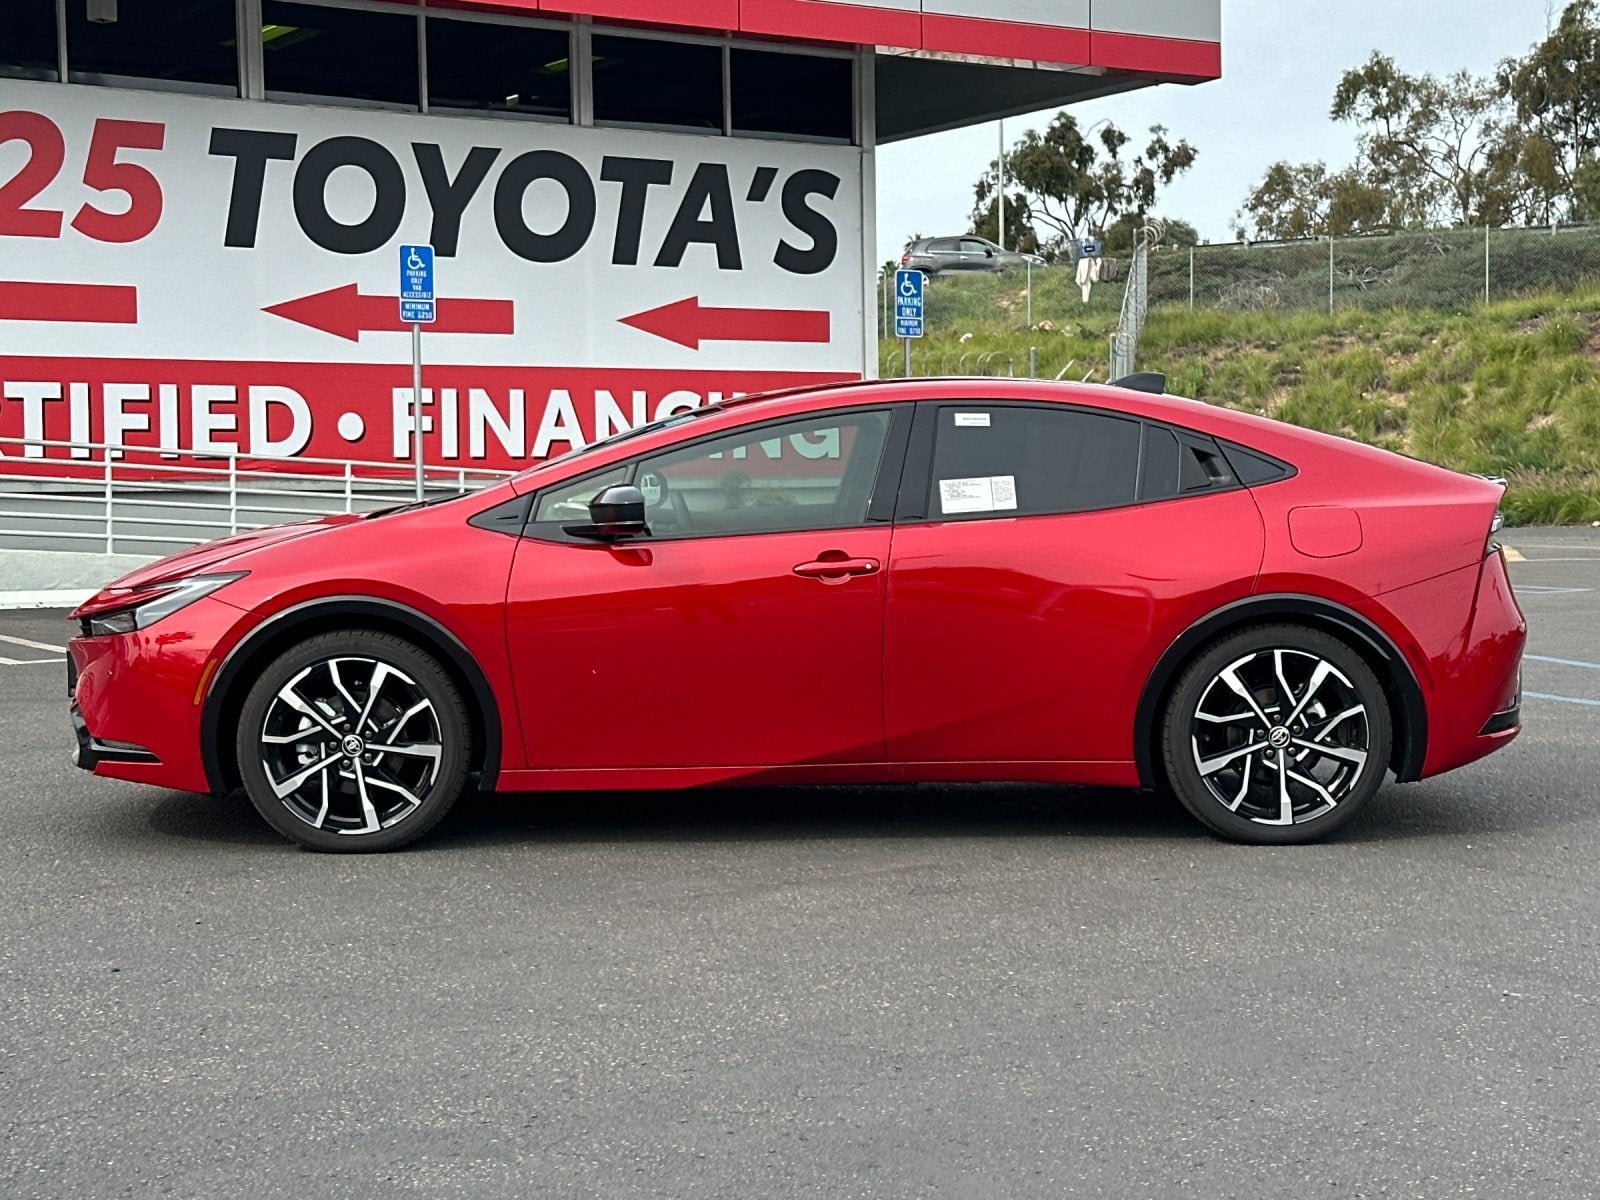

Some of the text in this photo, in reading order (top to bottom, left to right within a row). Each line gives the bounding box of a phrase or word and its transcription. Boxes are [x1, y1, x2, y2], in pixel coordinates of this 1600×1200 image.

[0, 110, 841, 275] 25 TOYOTA'S
[897, 296, 921, 307] PARKING
[402, 310, 415, 318] FINE
[901, 307, 917, 317] ONLY
[0, 381, 840, 460] TIFIED FINANG
